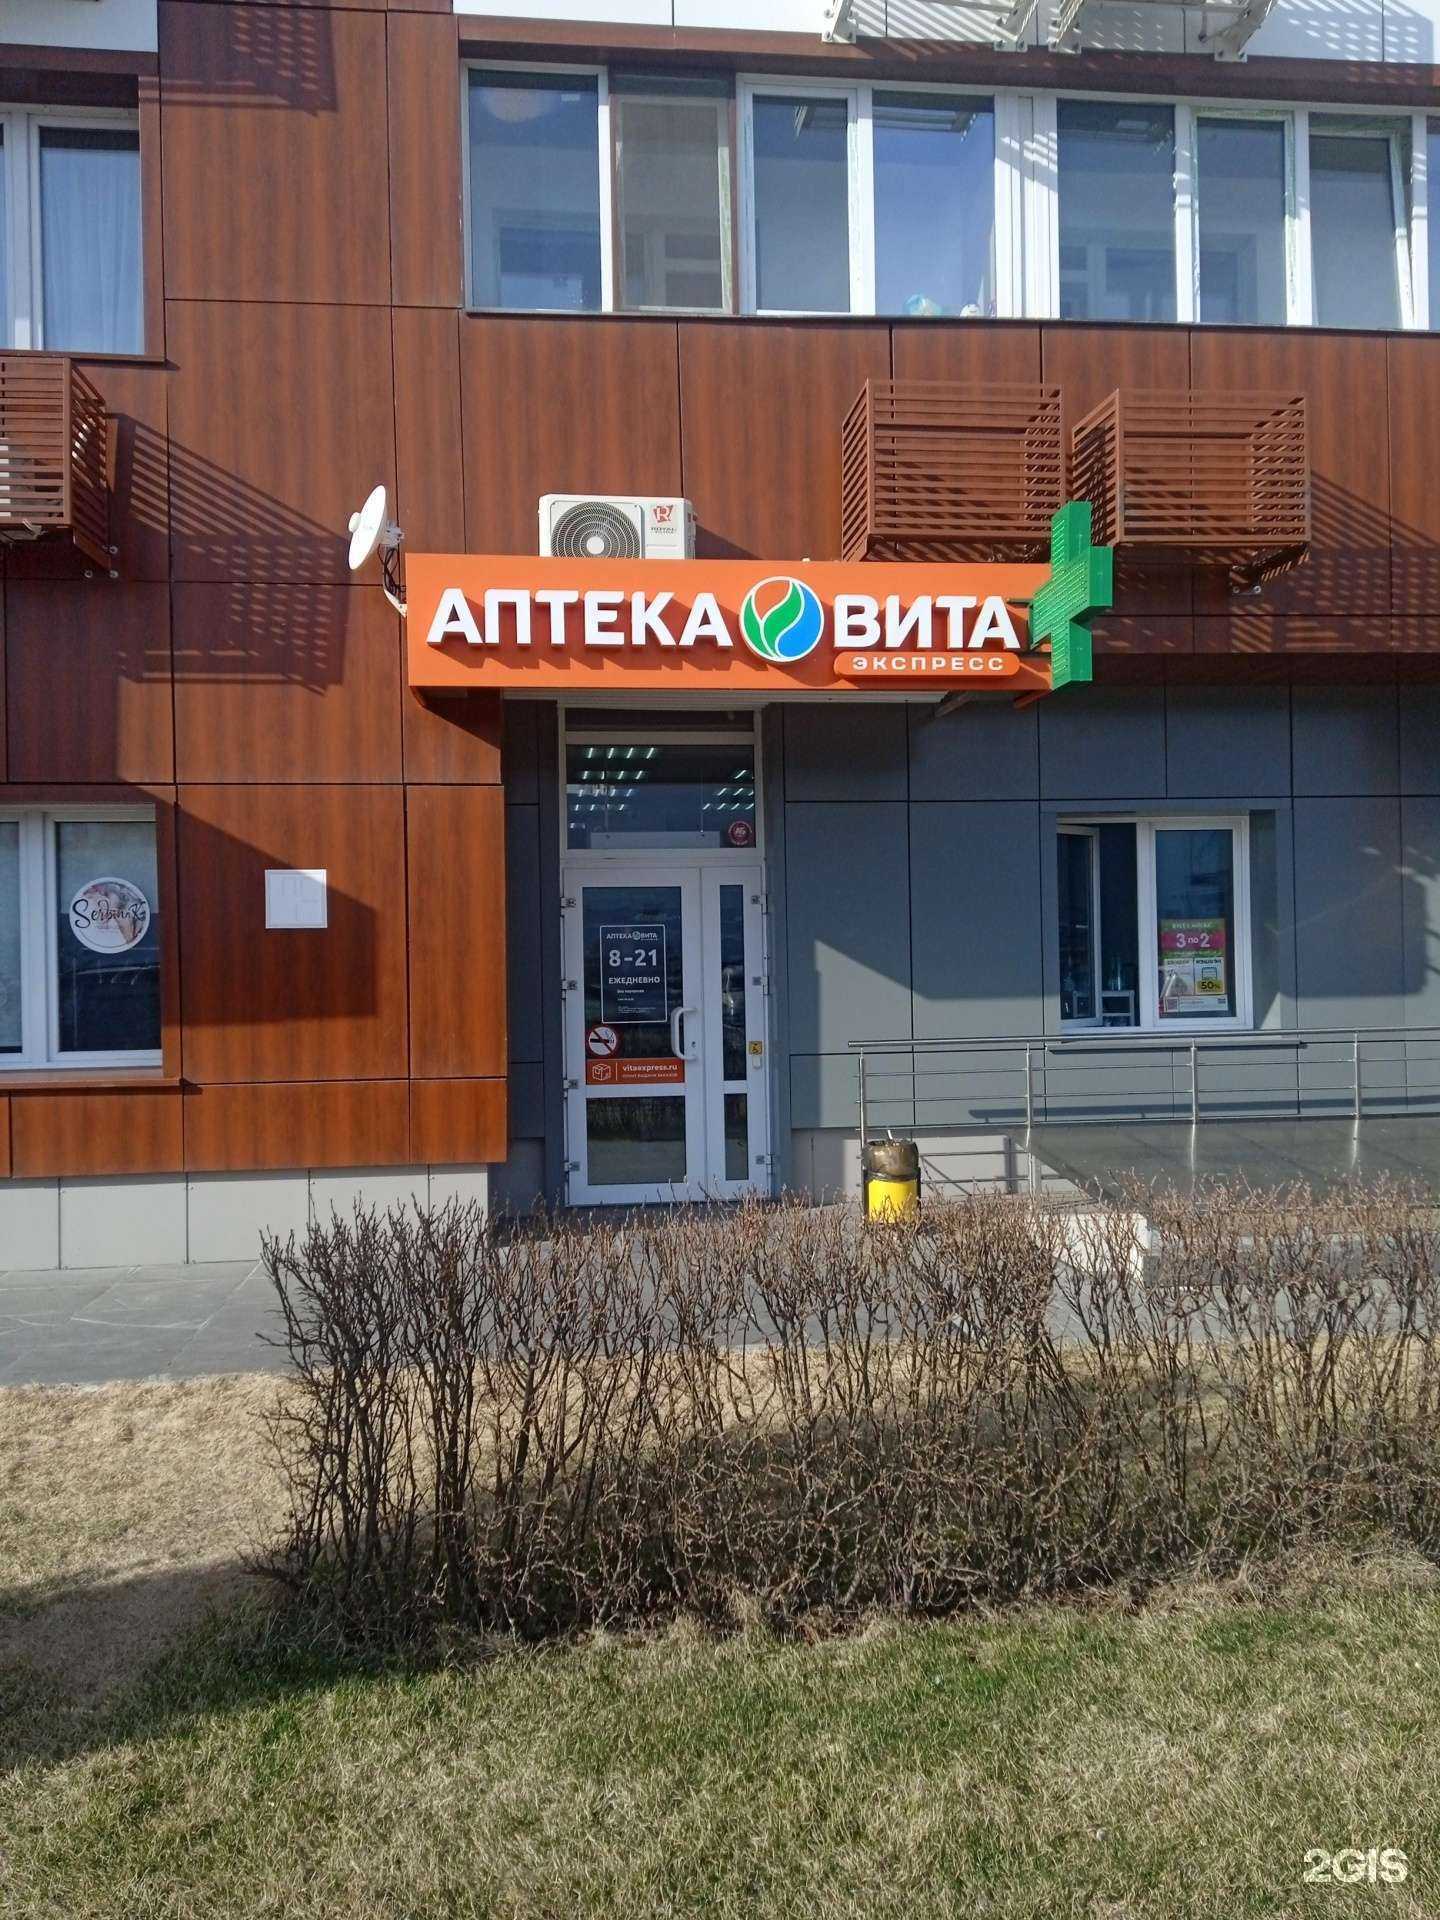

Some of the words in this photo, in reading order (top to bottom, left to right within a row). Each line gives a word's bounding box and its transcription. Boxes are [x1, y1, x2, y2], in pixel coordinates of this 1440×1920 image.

[427, 588, 733, 649] АПТЕКА
[832, 593, 1022, 650] ВИТА
[852, 656, 1006, 673] ЭКСПРЕСС
[1176, 933, 1186, 948] 3
[1200, 933, 1210, 948] 2
[608, 976, 661, 985] ЕЖЕДНЕВНО
